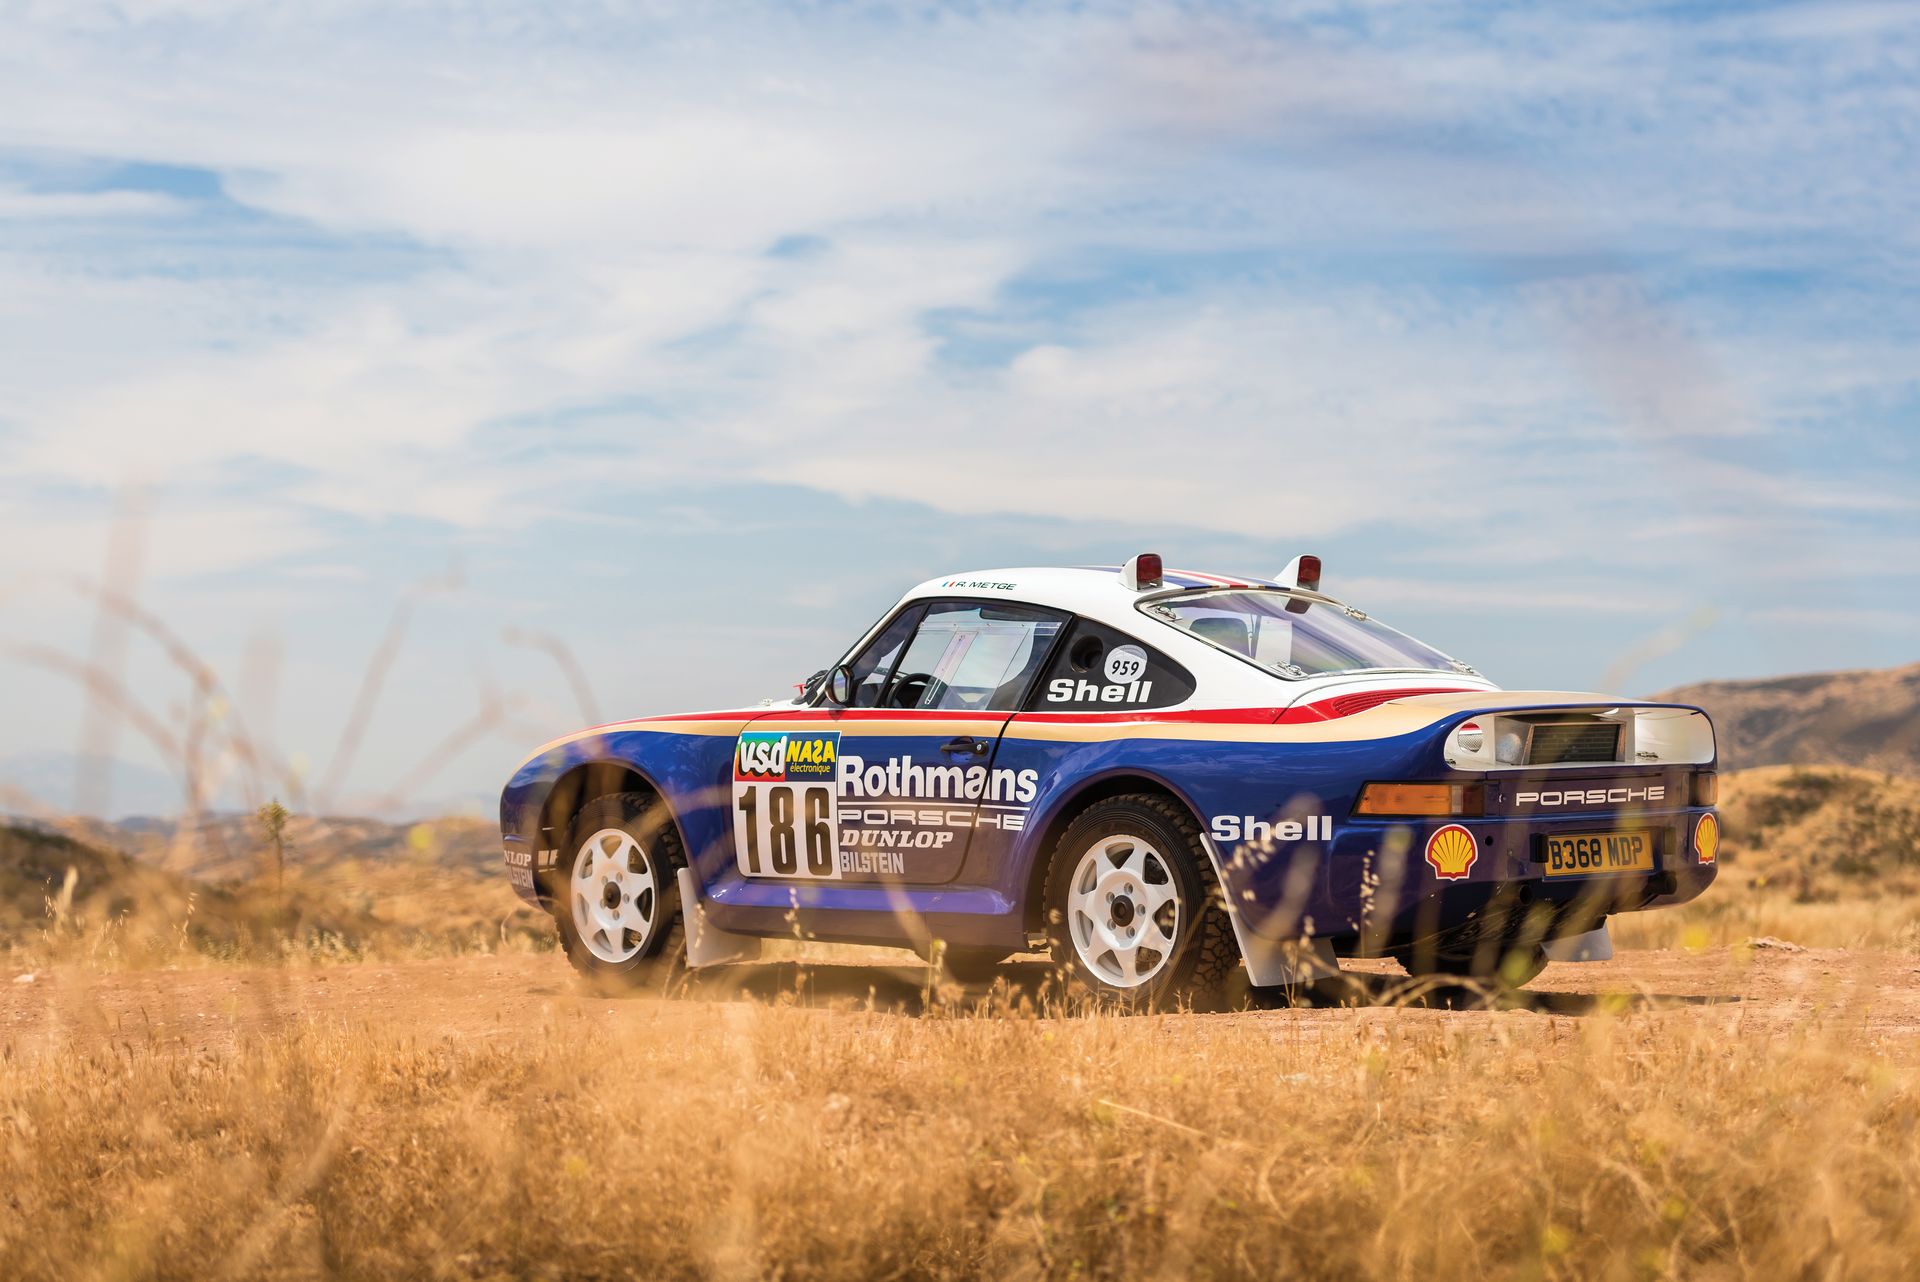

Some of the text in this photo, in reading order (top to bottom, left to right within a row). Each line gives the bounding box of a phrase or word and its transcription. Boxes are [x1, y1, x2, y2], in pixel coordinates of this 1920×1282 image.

[969, 581, 1017, 591] METGE
[1112, 660, 1139, 676] 959
[1047, 679, 1152, 703] Shell
[740, 735, 787, 774] vsd
[790, 763, 831, 776] électronique
[837, 755, 1039, 803] Rothmans
[1515, 785, 1665, 807] PORSCHE
[738, 785, 833, 876] 186
[838, 809, 1026, 831] PORSCHE
[1211, 815, 1332, 841] Shell
[840, 829, 954, 849] DUNLOP
[840, 851, 905, 874] BILSTEIN
[1550, 836, 1643, 870] B368 MDP
